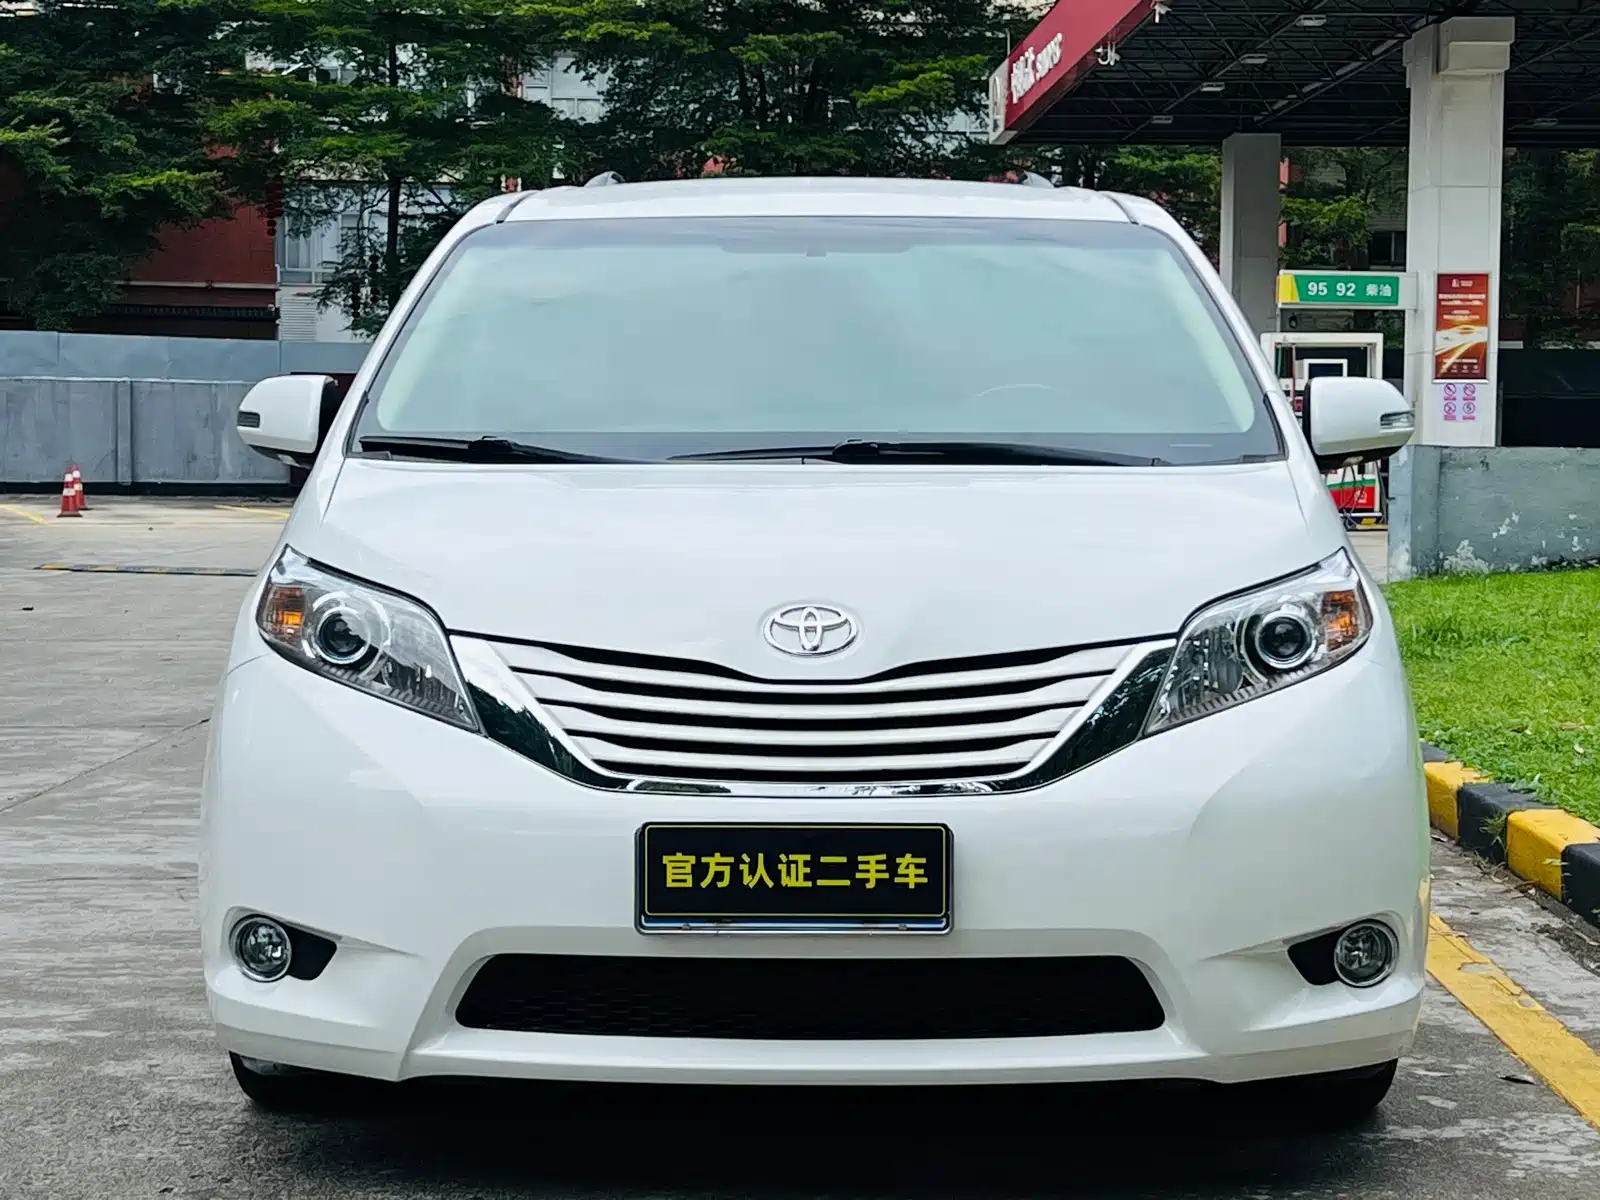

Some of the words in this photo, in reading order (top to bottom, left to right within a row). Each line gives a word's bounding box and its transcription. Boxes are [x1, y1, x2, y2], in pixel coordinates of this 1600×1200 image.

[1307, 281, 1328, 296] 95
[1336, 282, 1356, 297] 92
[661, 852, 929, 889] 官方认证二手车
